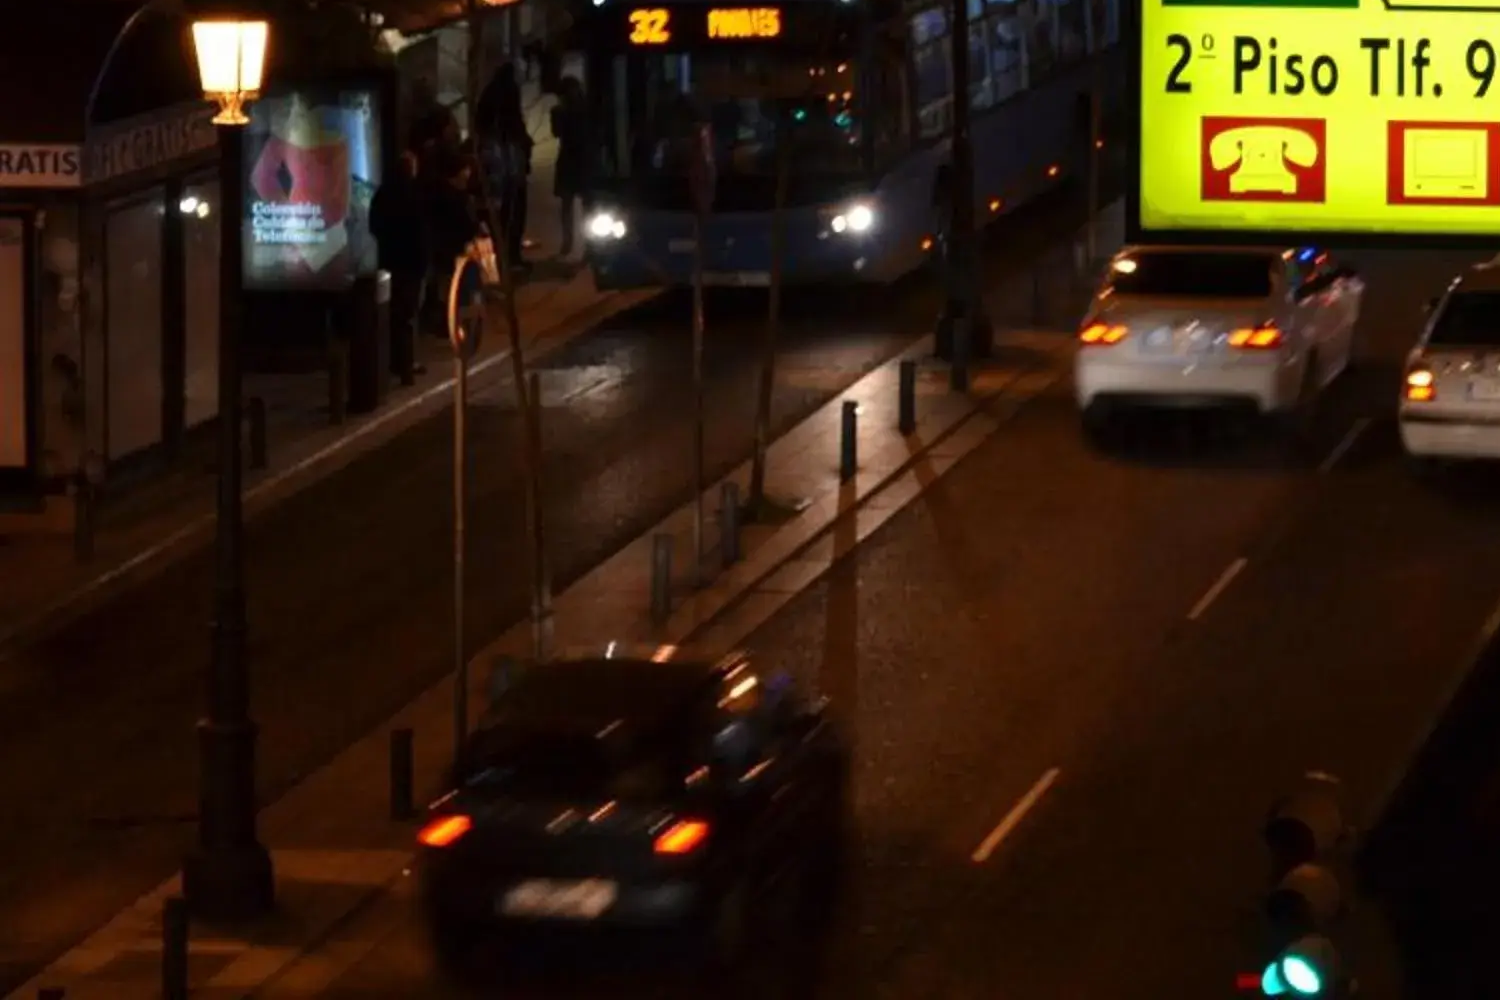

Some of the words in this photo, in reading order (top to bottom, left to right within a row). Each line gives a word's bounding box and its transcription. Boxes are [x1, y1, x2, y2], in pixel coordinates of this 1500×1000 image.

[628, 8, 671, 43] 32
[1233, 35, 1339, 96] Piso
[1360, 38, 1443, 96] Tlf.
